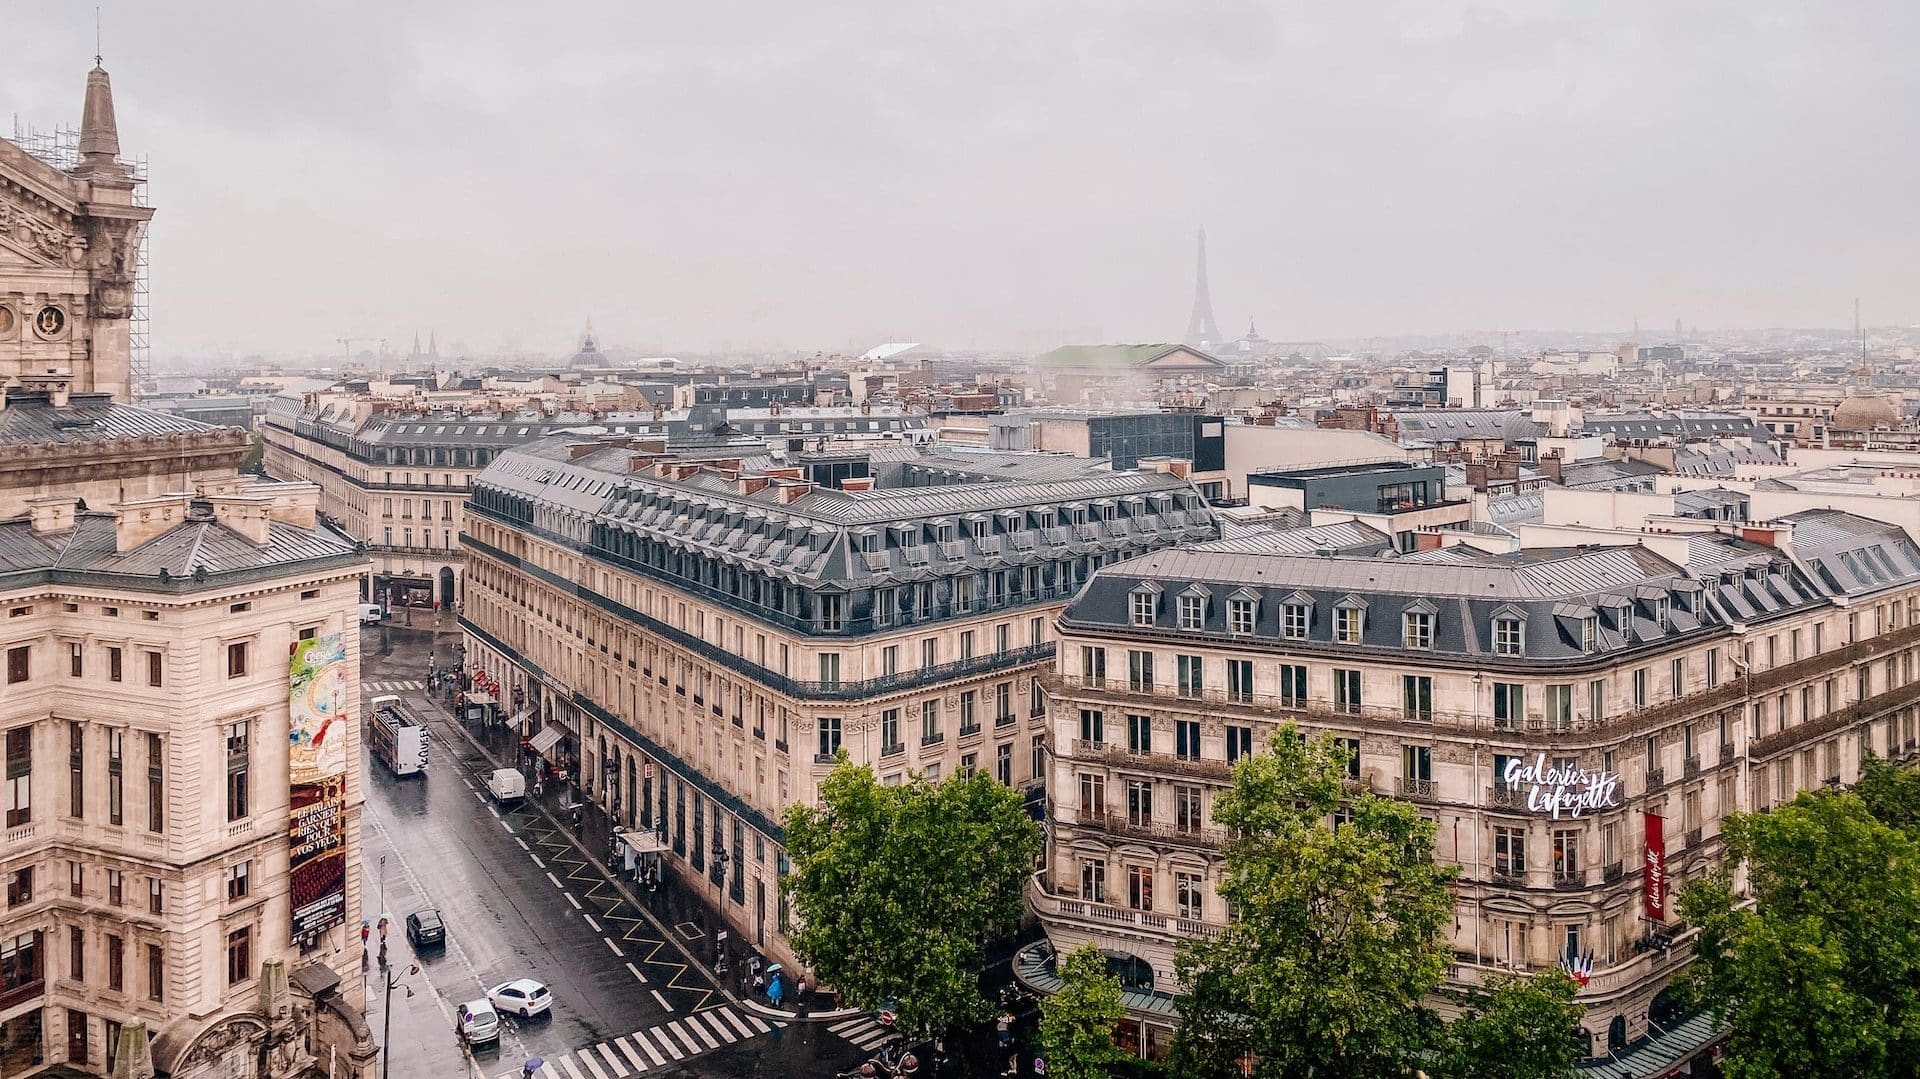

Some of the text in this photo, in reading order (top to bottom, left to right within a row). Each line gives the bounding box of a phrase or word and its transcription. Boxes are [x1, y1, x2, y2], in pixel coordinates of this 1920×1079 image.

[1503, 752, 1589, 791] Galeries
[1528, 772, 1620, 819] Lafayette
[310, 798, 340, 814] PALAIS
[298, 816, 338, 837] RIEN QUE
[299, 808, 336, 827] GARNIER
[297, 835, 338, 855] VOS YEUX
[306, 827, 330, 843] POUR
